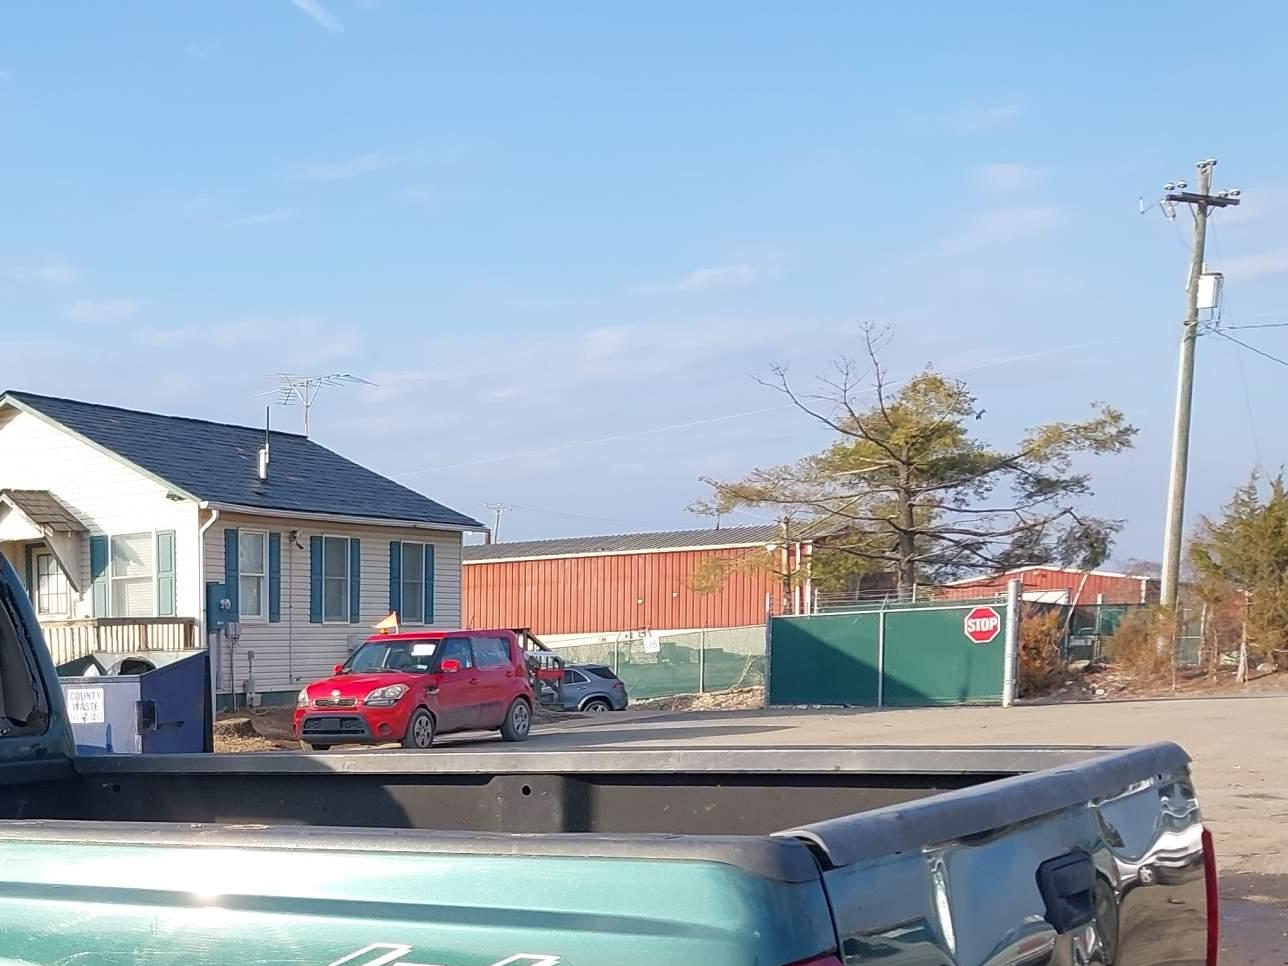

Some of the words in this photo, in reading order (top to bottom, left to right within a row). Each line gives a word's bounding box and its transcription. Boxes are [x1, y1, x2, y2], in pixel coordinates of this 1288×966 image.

[967, 617, 998, 632] STOP
[70, 691, 101, 701] COUNTY
[72, 702, 99, 711] WASTE
